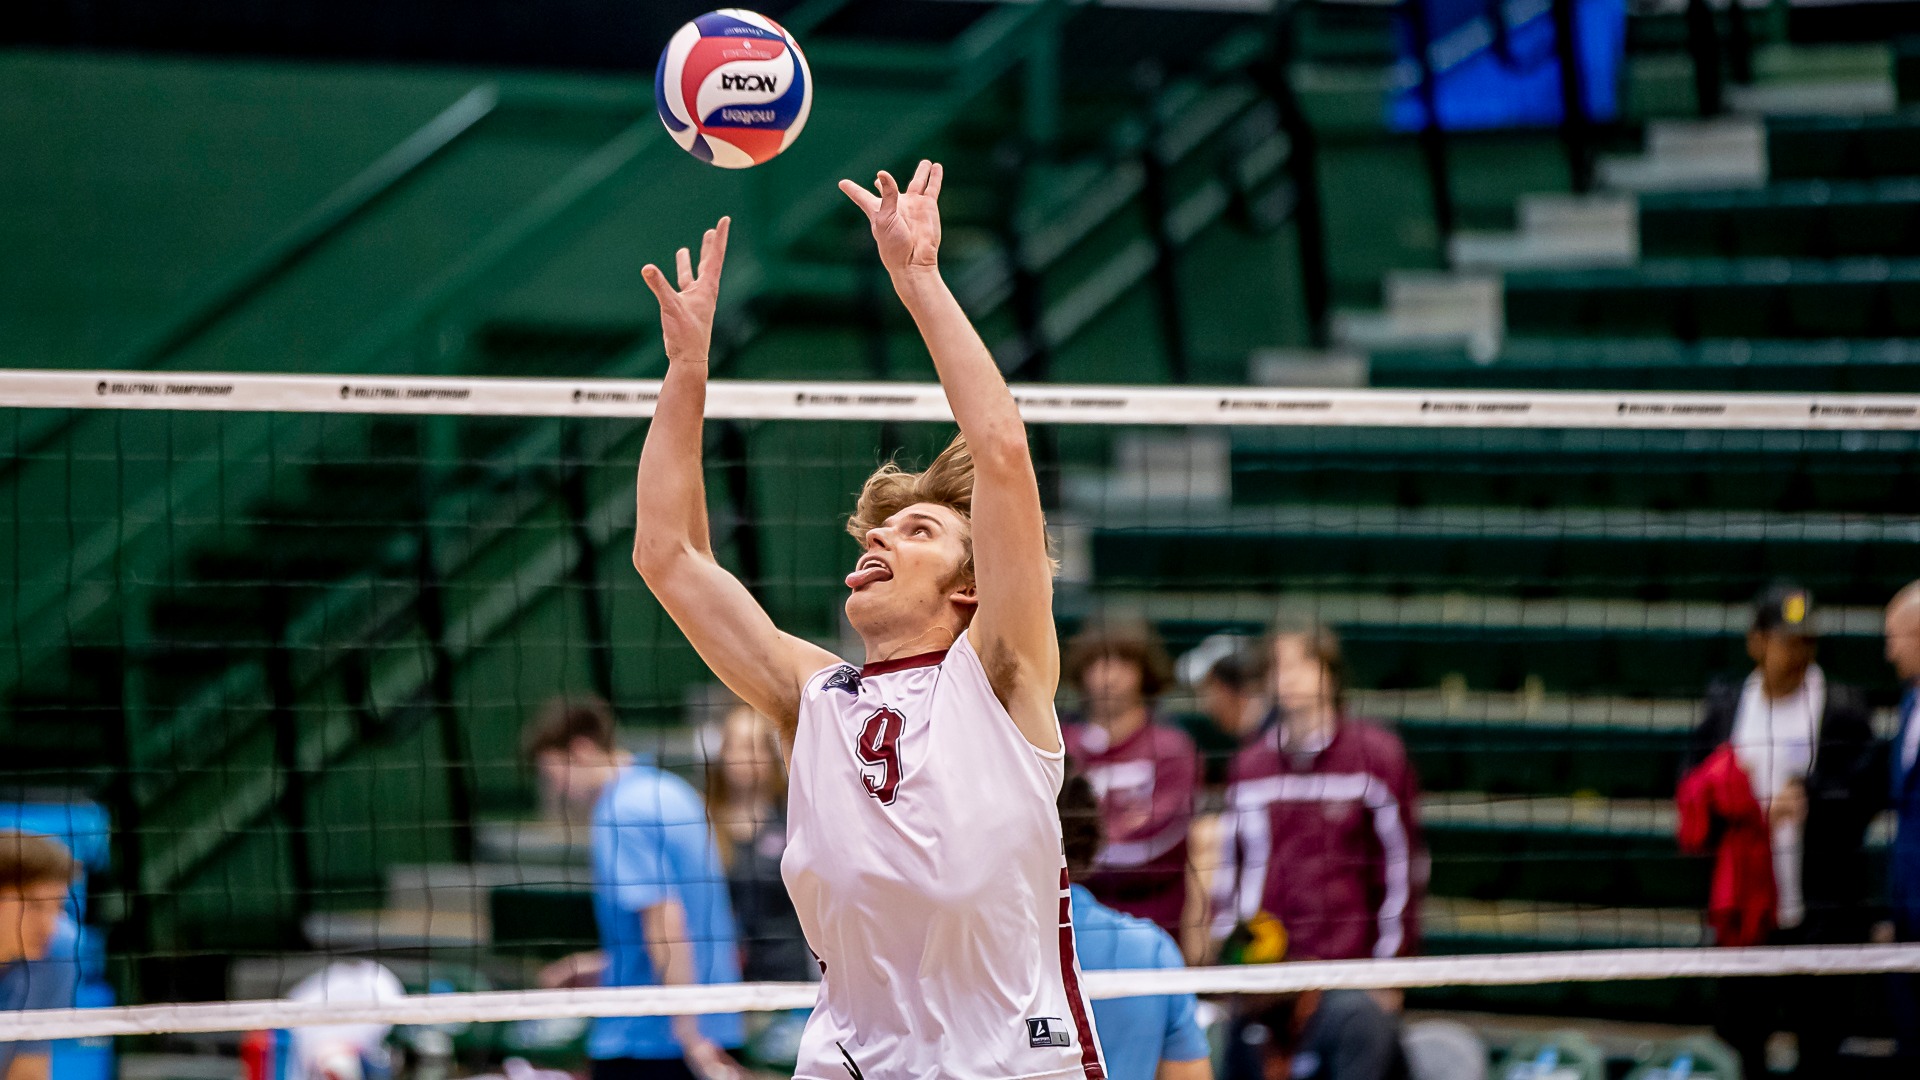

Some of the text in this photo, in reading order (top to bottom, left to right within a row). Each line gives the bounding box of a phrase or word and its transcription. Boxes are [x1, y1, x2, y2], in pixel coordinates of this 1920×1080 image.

[721, 73, 777, 93] NCAA
[722, 108, 776, 125] molten
[855, 703, 906, 806] 9
